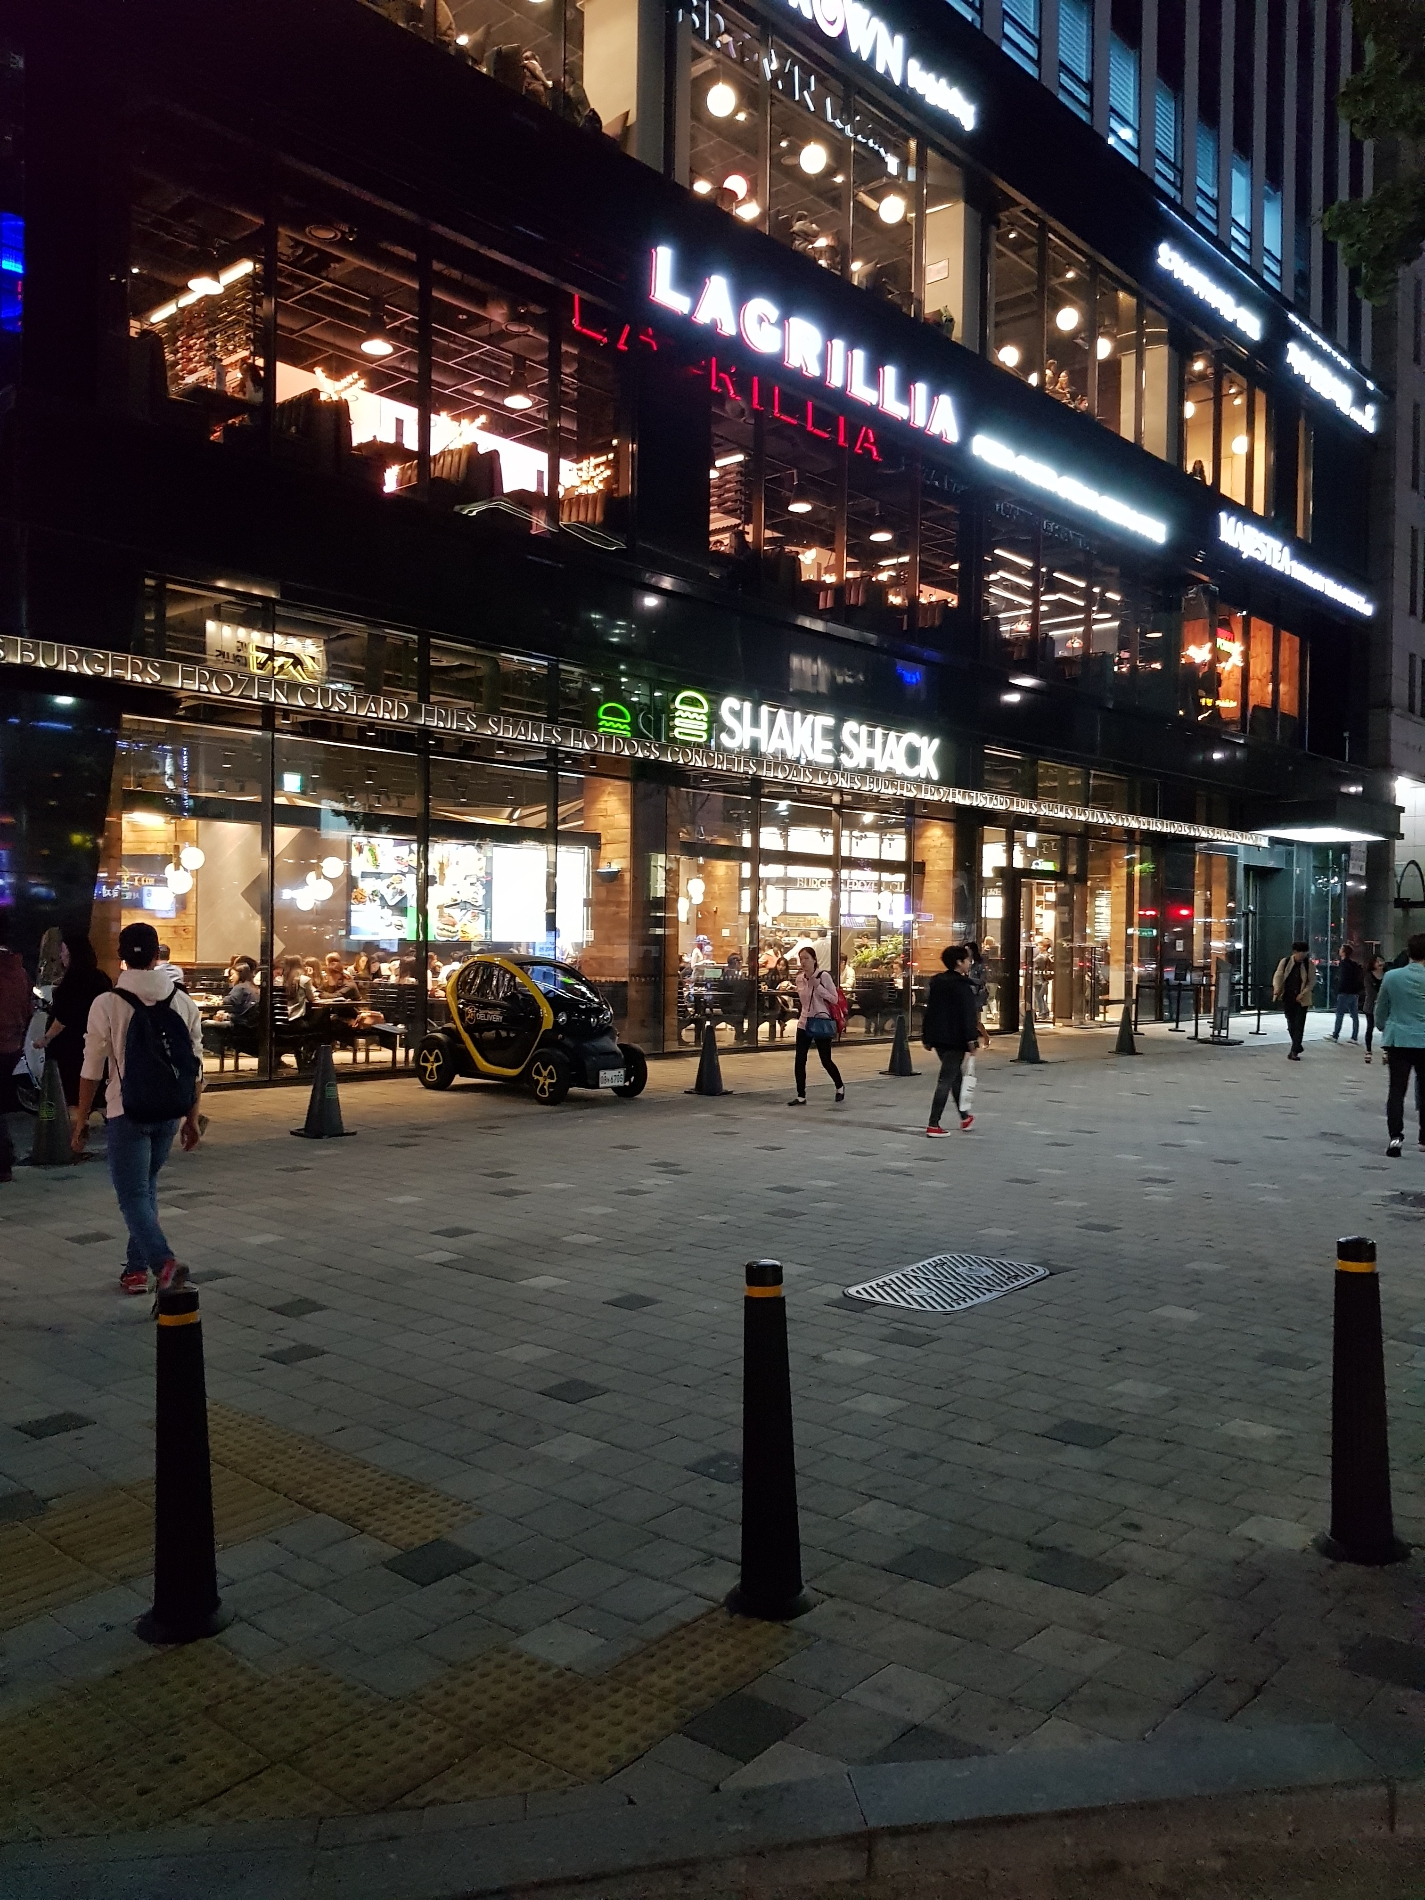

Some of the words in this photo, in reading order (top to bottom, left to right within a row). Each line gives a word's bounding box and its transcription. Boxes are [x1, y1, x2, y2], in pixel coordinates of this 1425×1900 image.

[17, 637, 162, 684] BURGERS
[179, 664, 289, 703] FROZEN
[299, 686, 409, 721] CUSTARD
[421, 704, 477, 732] FRIES
[487, 715, 562, 745] SHAKES
[667, 746, 757, 775] CONCRETES
[719, 697, 836, 764] SHAKE
[840, 720, 940, 781] SHACK
